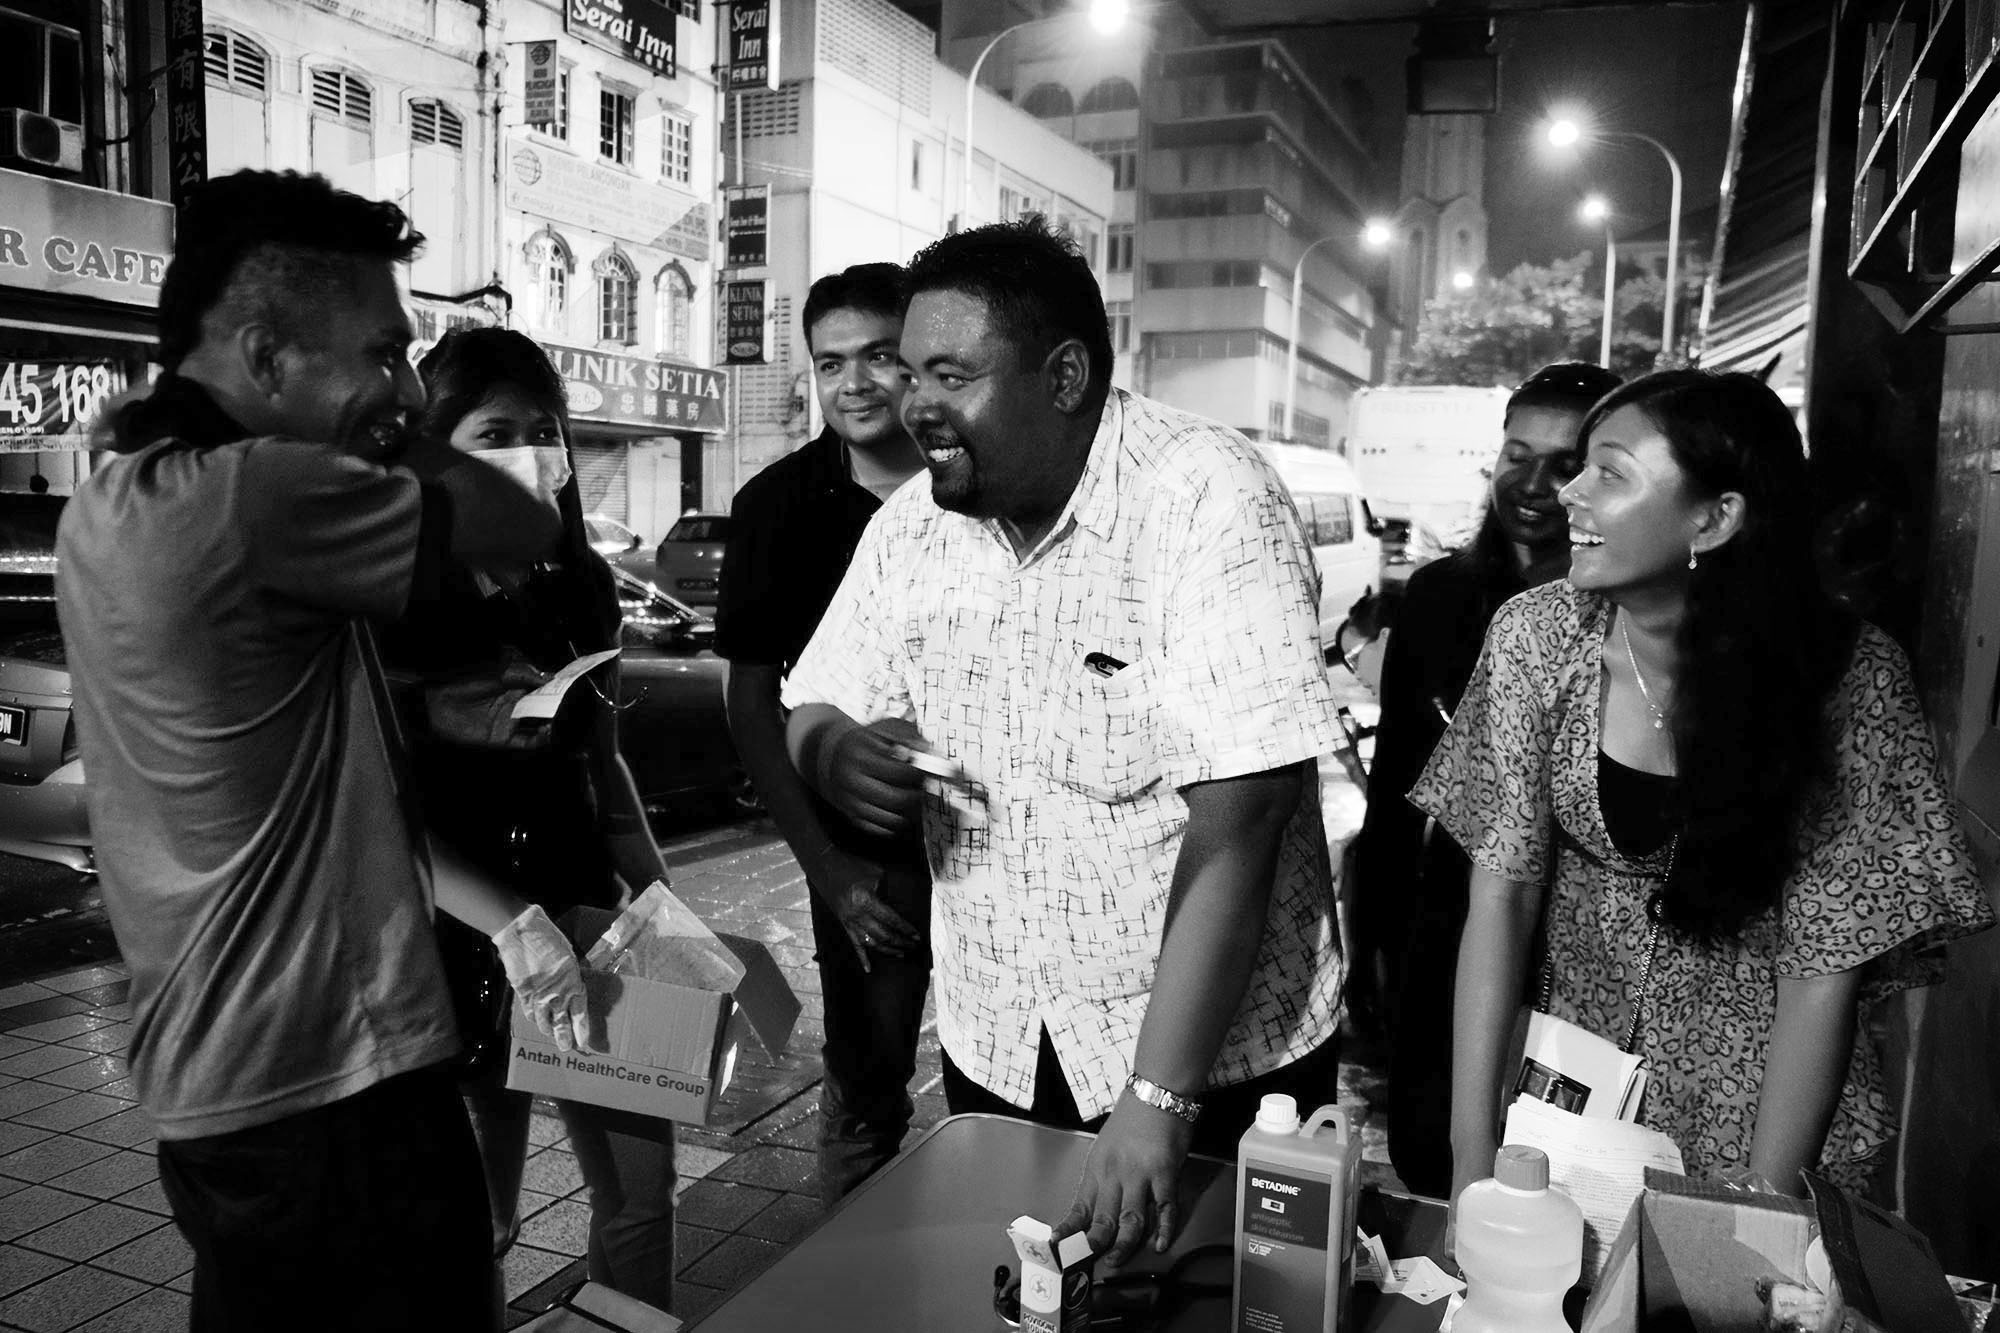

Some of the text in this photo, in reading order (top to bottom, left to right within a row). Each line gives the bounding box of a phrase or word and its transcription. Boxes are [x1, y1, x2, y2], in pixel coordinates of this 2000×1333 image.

[732, 1, 768, 32] Serai
[573, 0, 633, 43] Serai
[637, 26, 674, 62] Inn
[738, 34, 761, 59] Inn
[172, 0, 202, 208] 隆有限公
[43, 235, 166, 288] CAFE
[729, 287, 762, 303] KLINIK
[732, 305, 760, 321] SETIA
[645, 365, 720, 400] SETIA
[516, 1046, 705, 1097] Antah HealthCare Group
[1251, 1177, 1300, 1196] BETADINE
[1251, 1213, 1293, 1229] antiseptic
[1251, 1223, 1268, 1234] skin
